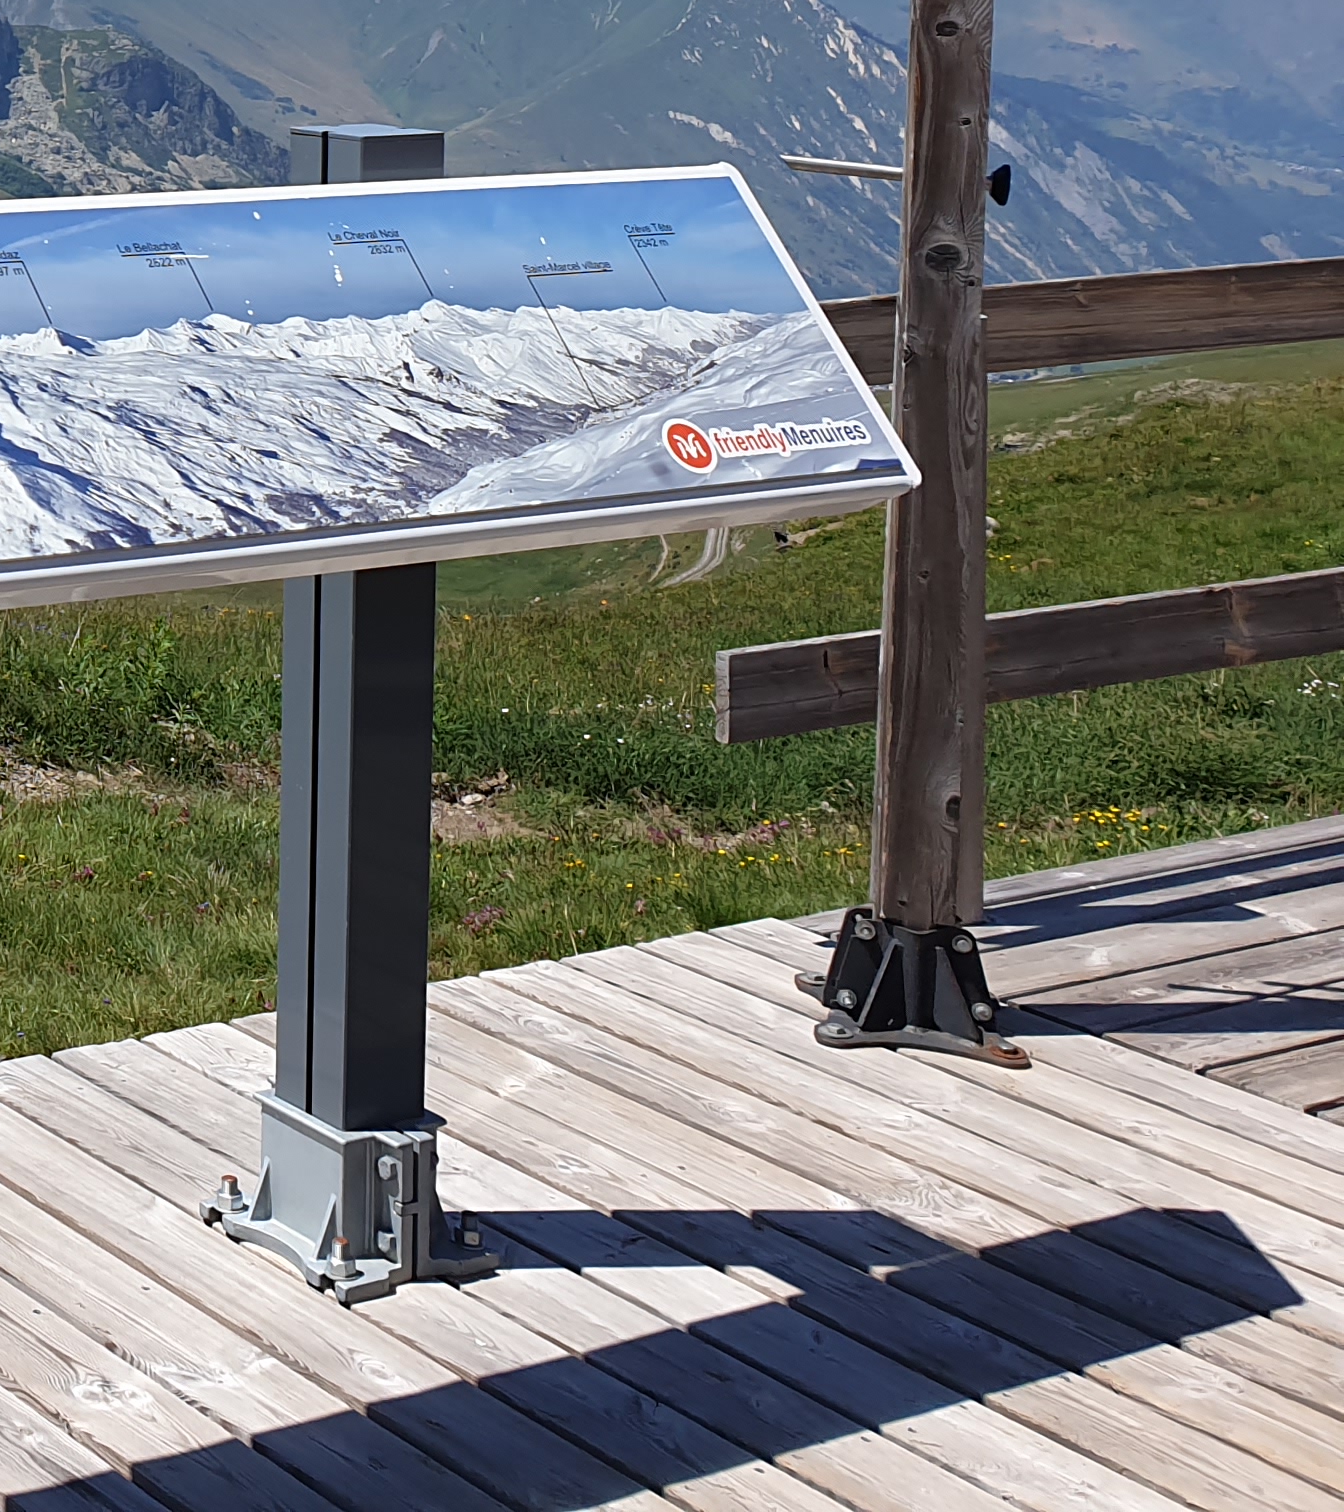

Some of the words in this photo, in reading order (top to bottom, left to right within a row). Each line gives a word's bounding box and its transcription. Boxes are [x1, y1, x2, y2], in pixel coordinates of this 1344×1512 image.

[327, 231, 343, 242] Le
[343, 229, 378, 240] Cheval
[378, 228, 400, 238] Noir
[116, 243, 132, 254] Le
[395, 245, 406, 253] m
[175, 258, 187, 266] m
[13, 267, 25, 276] m
